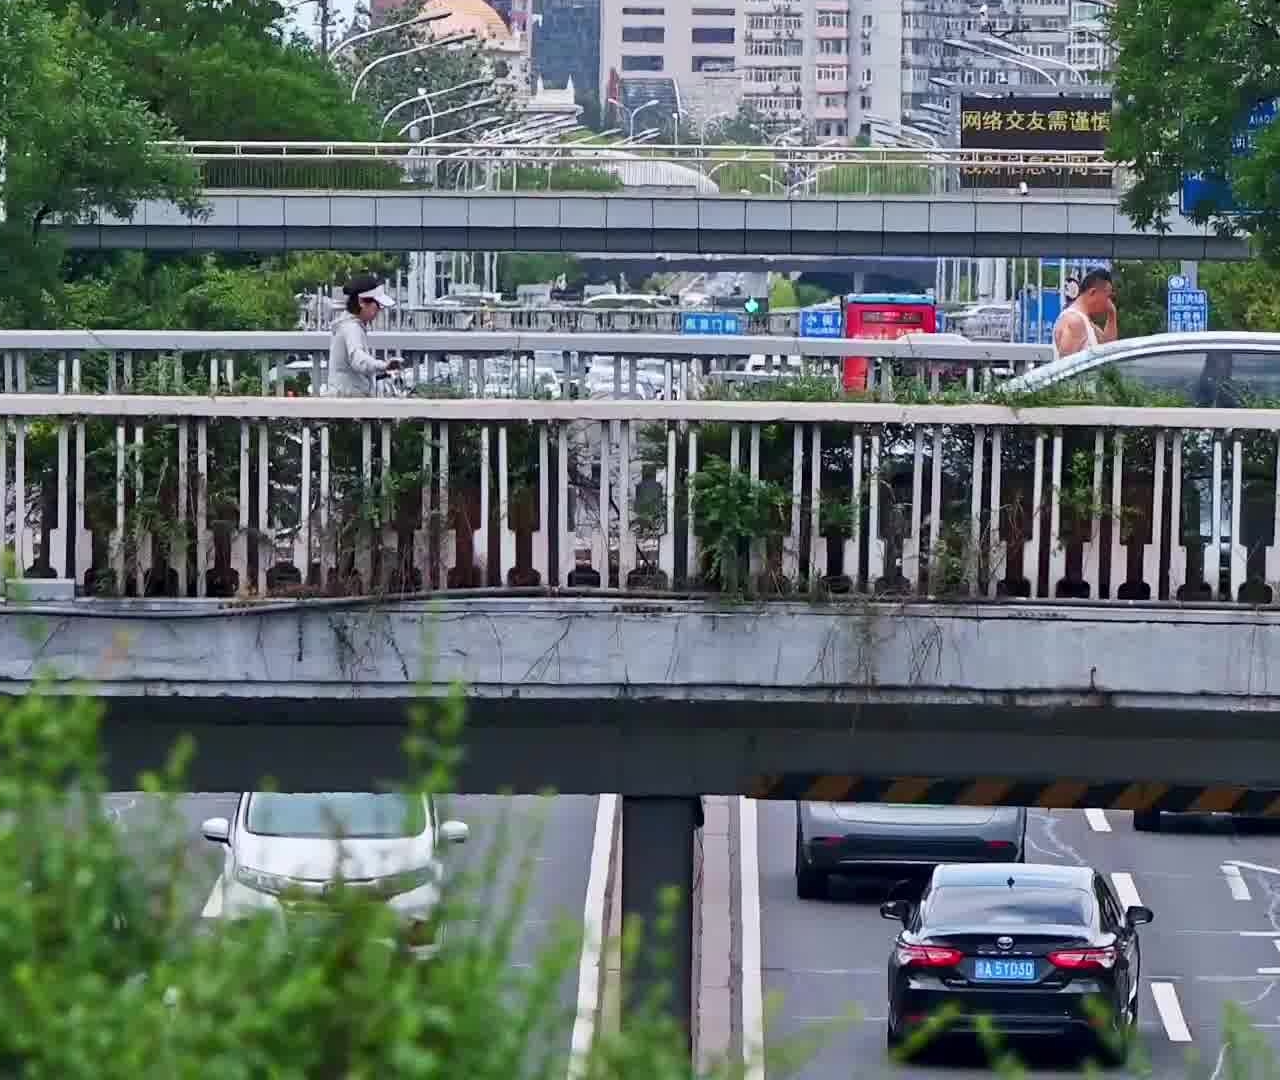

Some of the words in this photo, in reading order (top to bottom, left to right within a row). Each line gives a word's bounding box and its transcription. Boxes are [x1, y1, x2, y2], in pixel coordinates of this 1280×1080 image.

[961, 110, 1112, 132] 网络交友需谨慎
